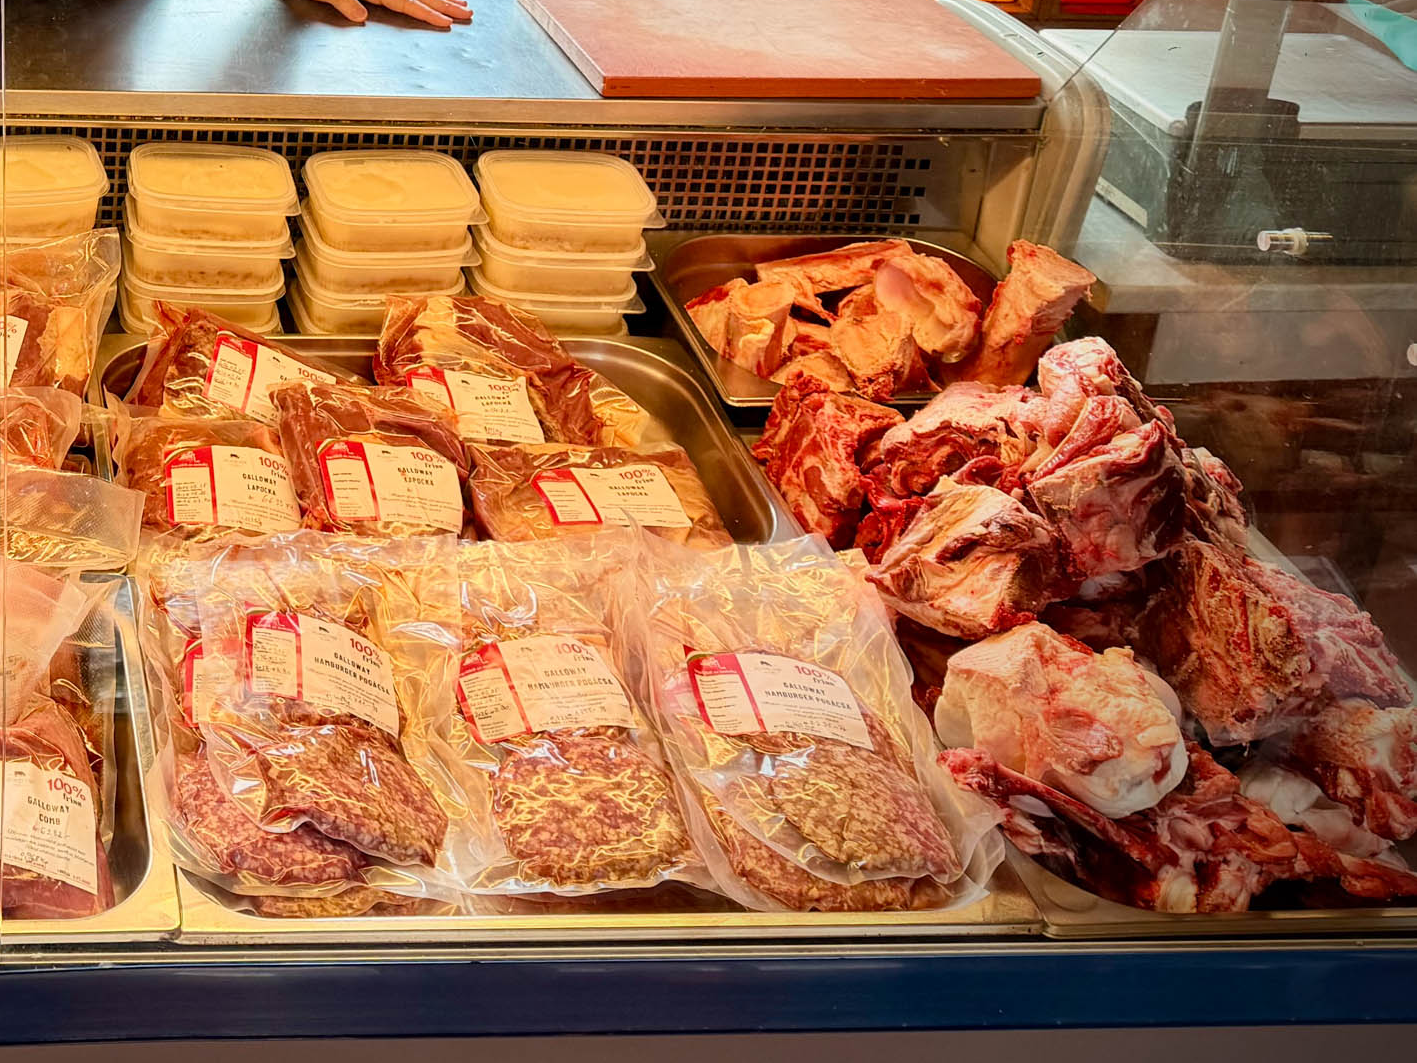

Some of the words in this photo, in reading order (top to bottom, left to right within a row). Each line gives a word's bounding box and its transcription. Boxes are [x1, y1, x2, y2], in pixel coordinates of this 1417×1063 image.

[411, 451, 446, 464] 100%
[259, 456, 289, 476] 100%
[397, 467, 433, 475] GALLOWAY
[242, 473, 277, 486] GALLOWAY
[619, 469, 656, 480] 100%
[247, 484, 276, 496] LAPOCKA
[349, 638, 383, 665] 100%
[314, 656, 357, 679] HAMBURGER
[334, 652, 370, 675] GALLOWAY
[544, 668, 587, 678] GALLOWAY
[783, 682, 825, 696] GALLOWAY
[764, 690, 814, 702] HAMBURGER
[47, 778, 86, 802] 100%
[27, 796, 70, 814] GALLOWAY
[39, 813, 61, 825] COMB
